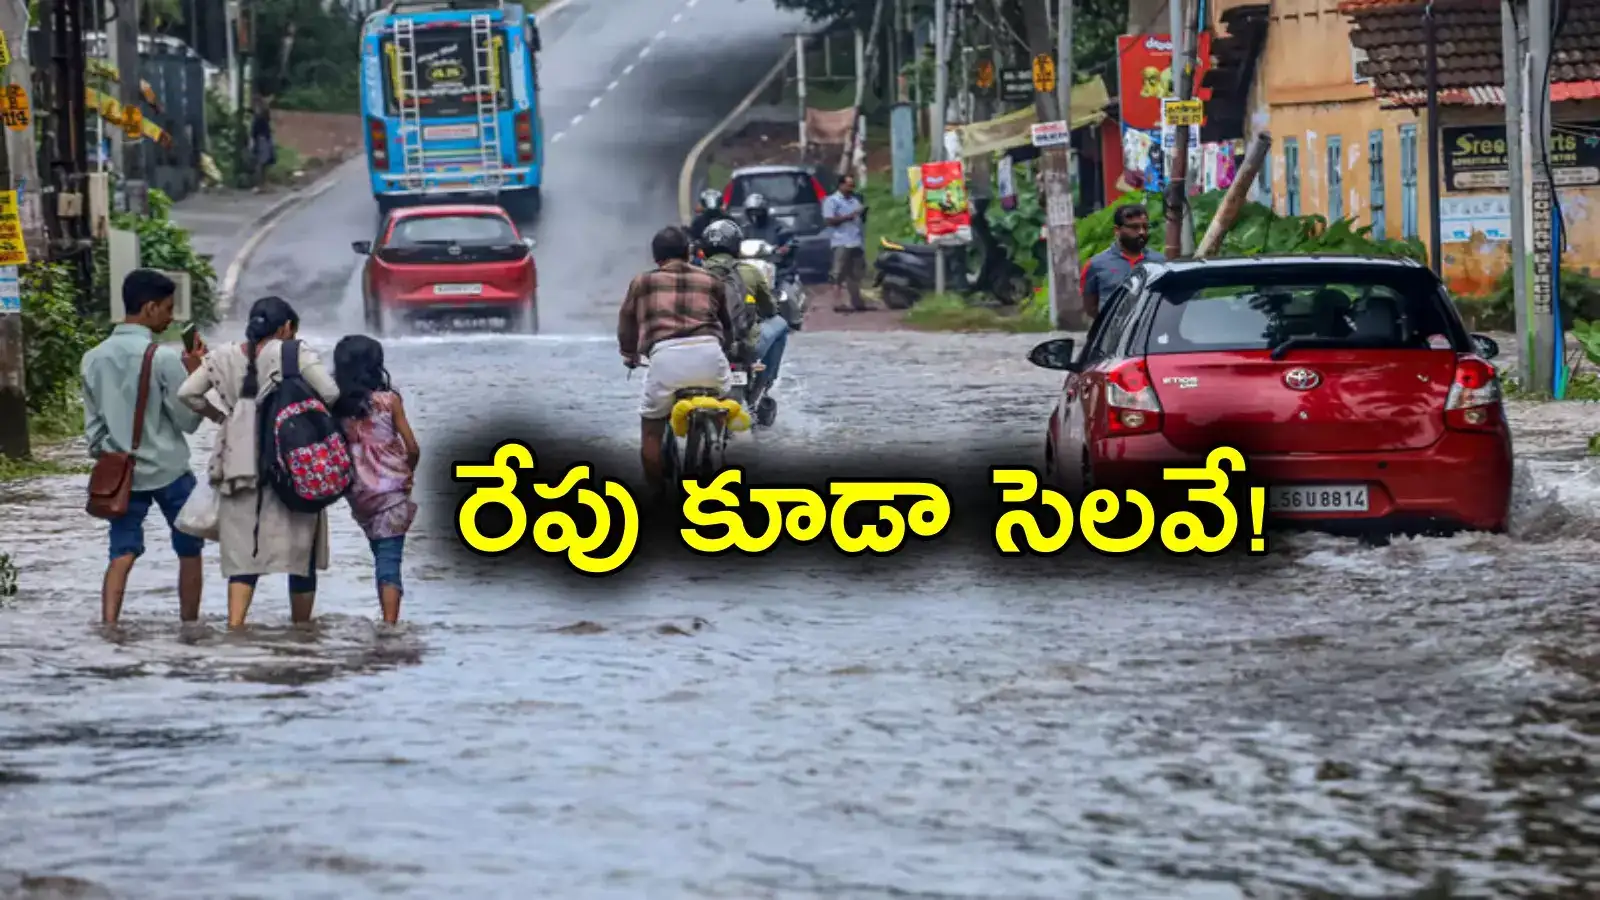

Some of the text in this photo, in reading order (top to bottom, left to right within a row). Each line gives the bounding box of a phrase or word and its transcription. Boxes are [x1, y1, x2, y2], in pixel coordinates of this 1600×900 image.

[1550, 133, 1577, 151] rts
[1281, 490, 1365, 507] 56 U 8814
